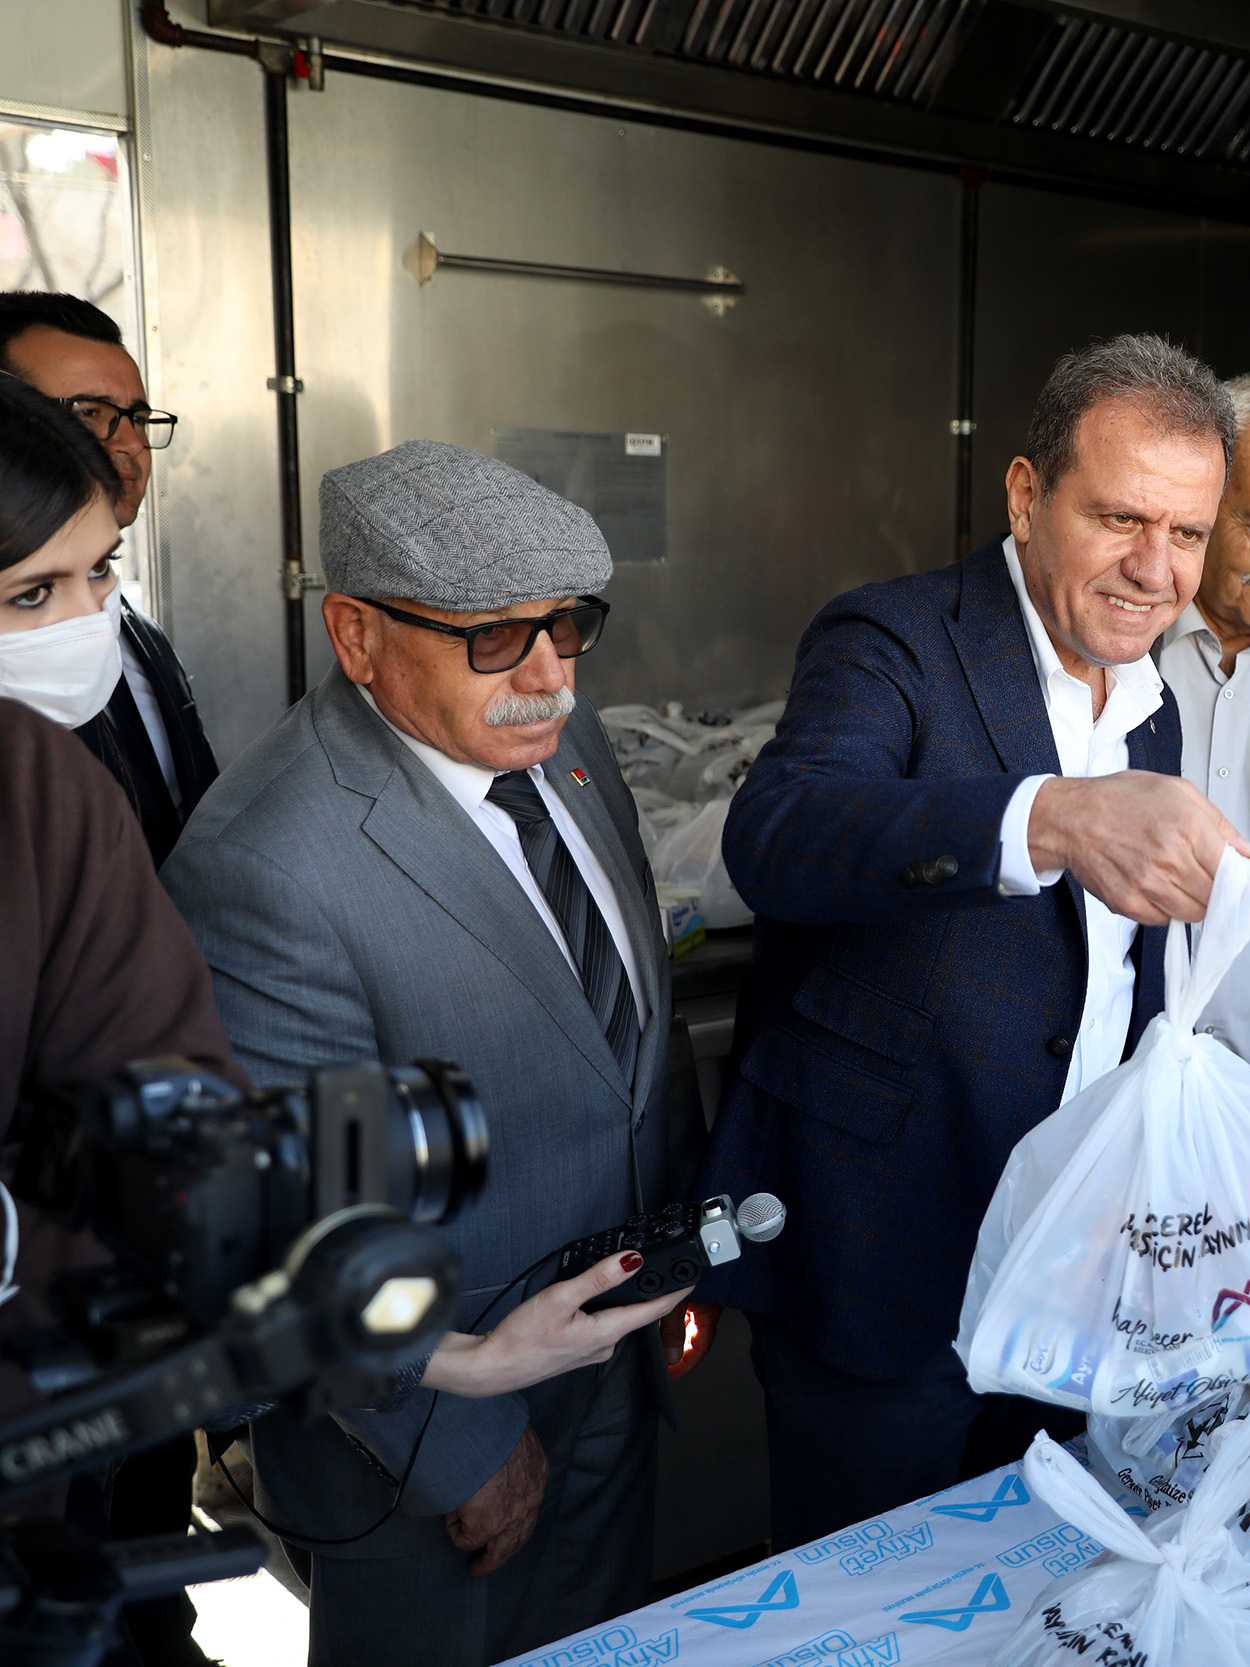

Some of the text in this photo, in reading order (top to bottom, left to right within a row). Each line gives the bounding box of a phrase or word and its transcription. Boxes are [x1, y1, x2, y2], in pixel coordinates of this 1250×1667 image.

[1111, 1378, 1185, 1408] Afiyet
[0, 1408, 124, 1482] CRANE
[801, 1522, 888, 1562] Olsun
[846, 1526, 928, 1571] Afiyet
[1003, 1525, 1084, 1565] Olsun
